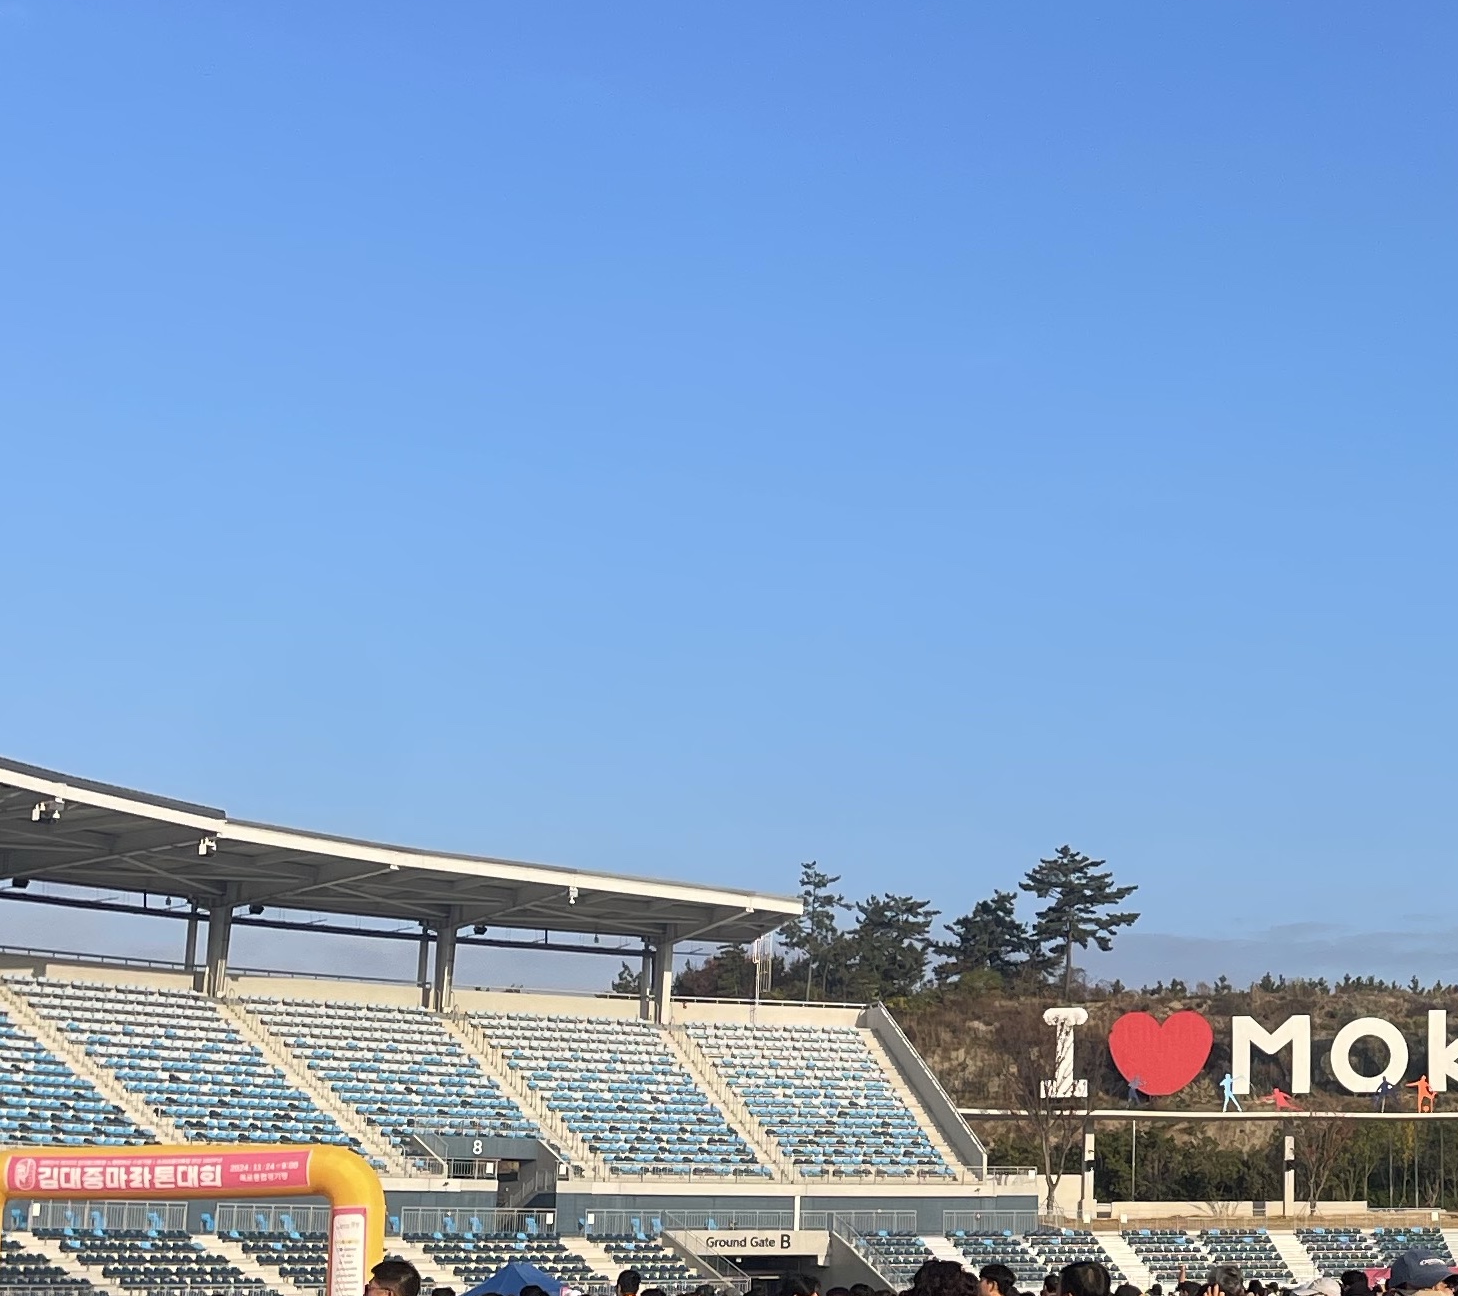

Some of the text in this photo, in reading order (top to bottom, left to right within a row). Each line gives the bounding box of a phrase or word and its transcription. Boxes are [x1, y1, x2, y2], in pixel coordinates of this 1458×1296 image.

[1040, 1007, 1088, 1098] I
[473, 1139, 483, 1155] 8
[38, 1164, 222, 1190] 김대중마라톤대회
[706, 1234, 791, 1249] Ground Gate B
